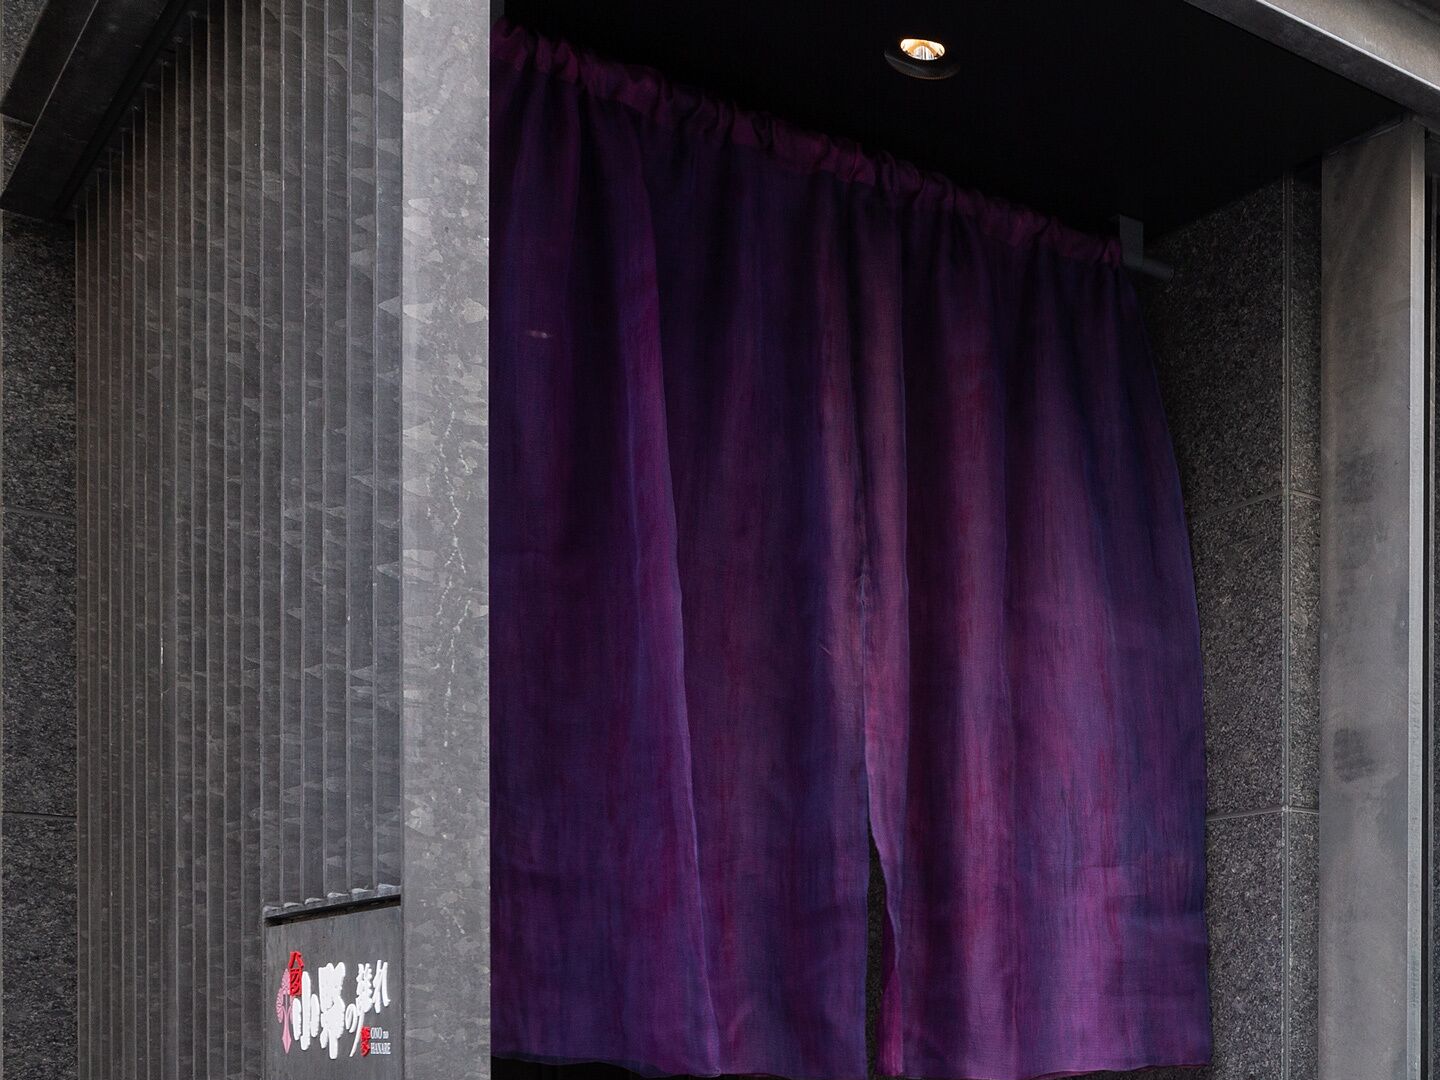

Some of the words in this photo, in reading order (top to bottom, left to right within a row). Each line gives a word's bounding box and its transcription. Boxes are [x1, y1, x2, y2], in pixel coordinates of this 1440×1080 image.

[293, 960, 391, 1060] 小野の離れ
